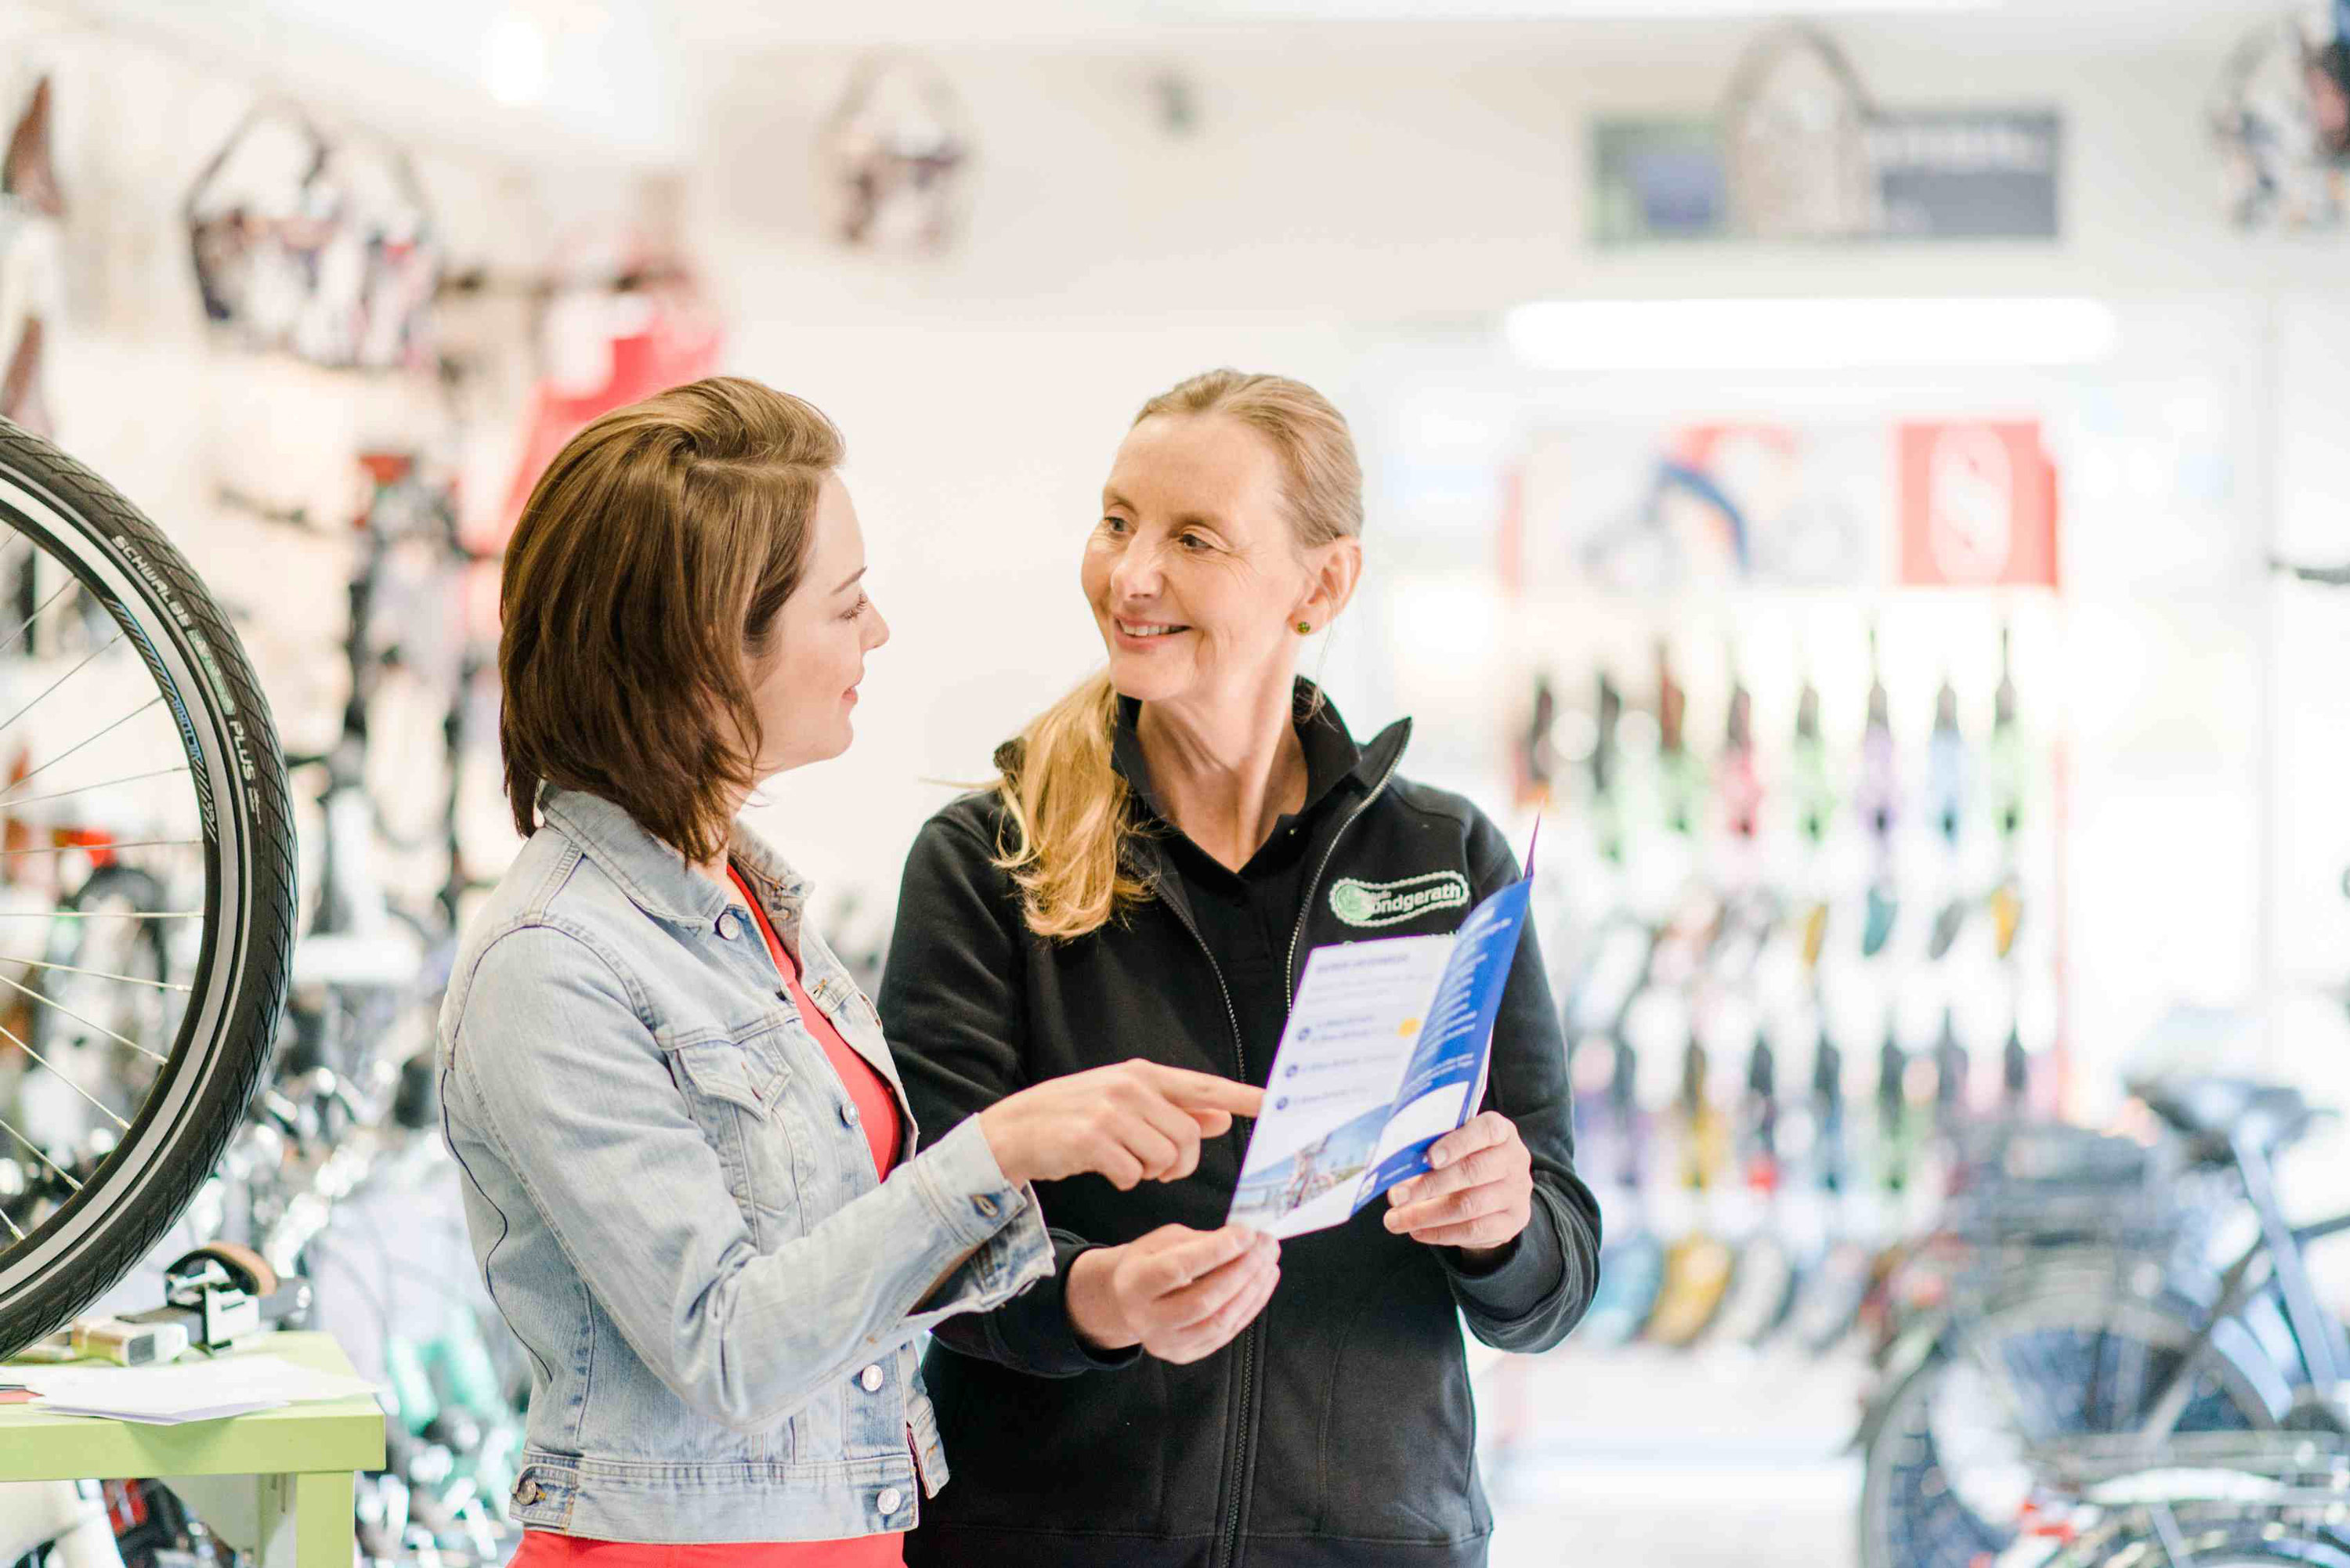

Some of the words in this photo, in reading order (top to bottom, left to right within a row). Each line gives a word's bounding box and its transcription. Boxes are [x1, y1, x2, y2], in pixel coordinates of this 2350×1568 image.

[111, 535, 193, 627] SCHWALBE
[229, 720, 256, 782] PLUS
[1361, 882, 1462, 915] ondgerath
